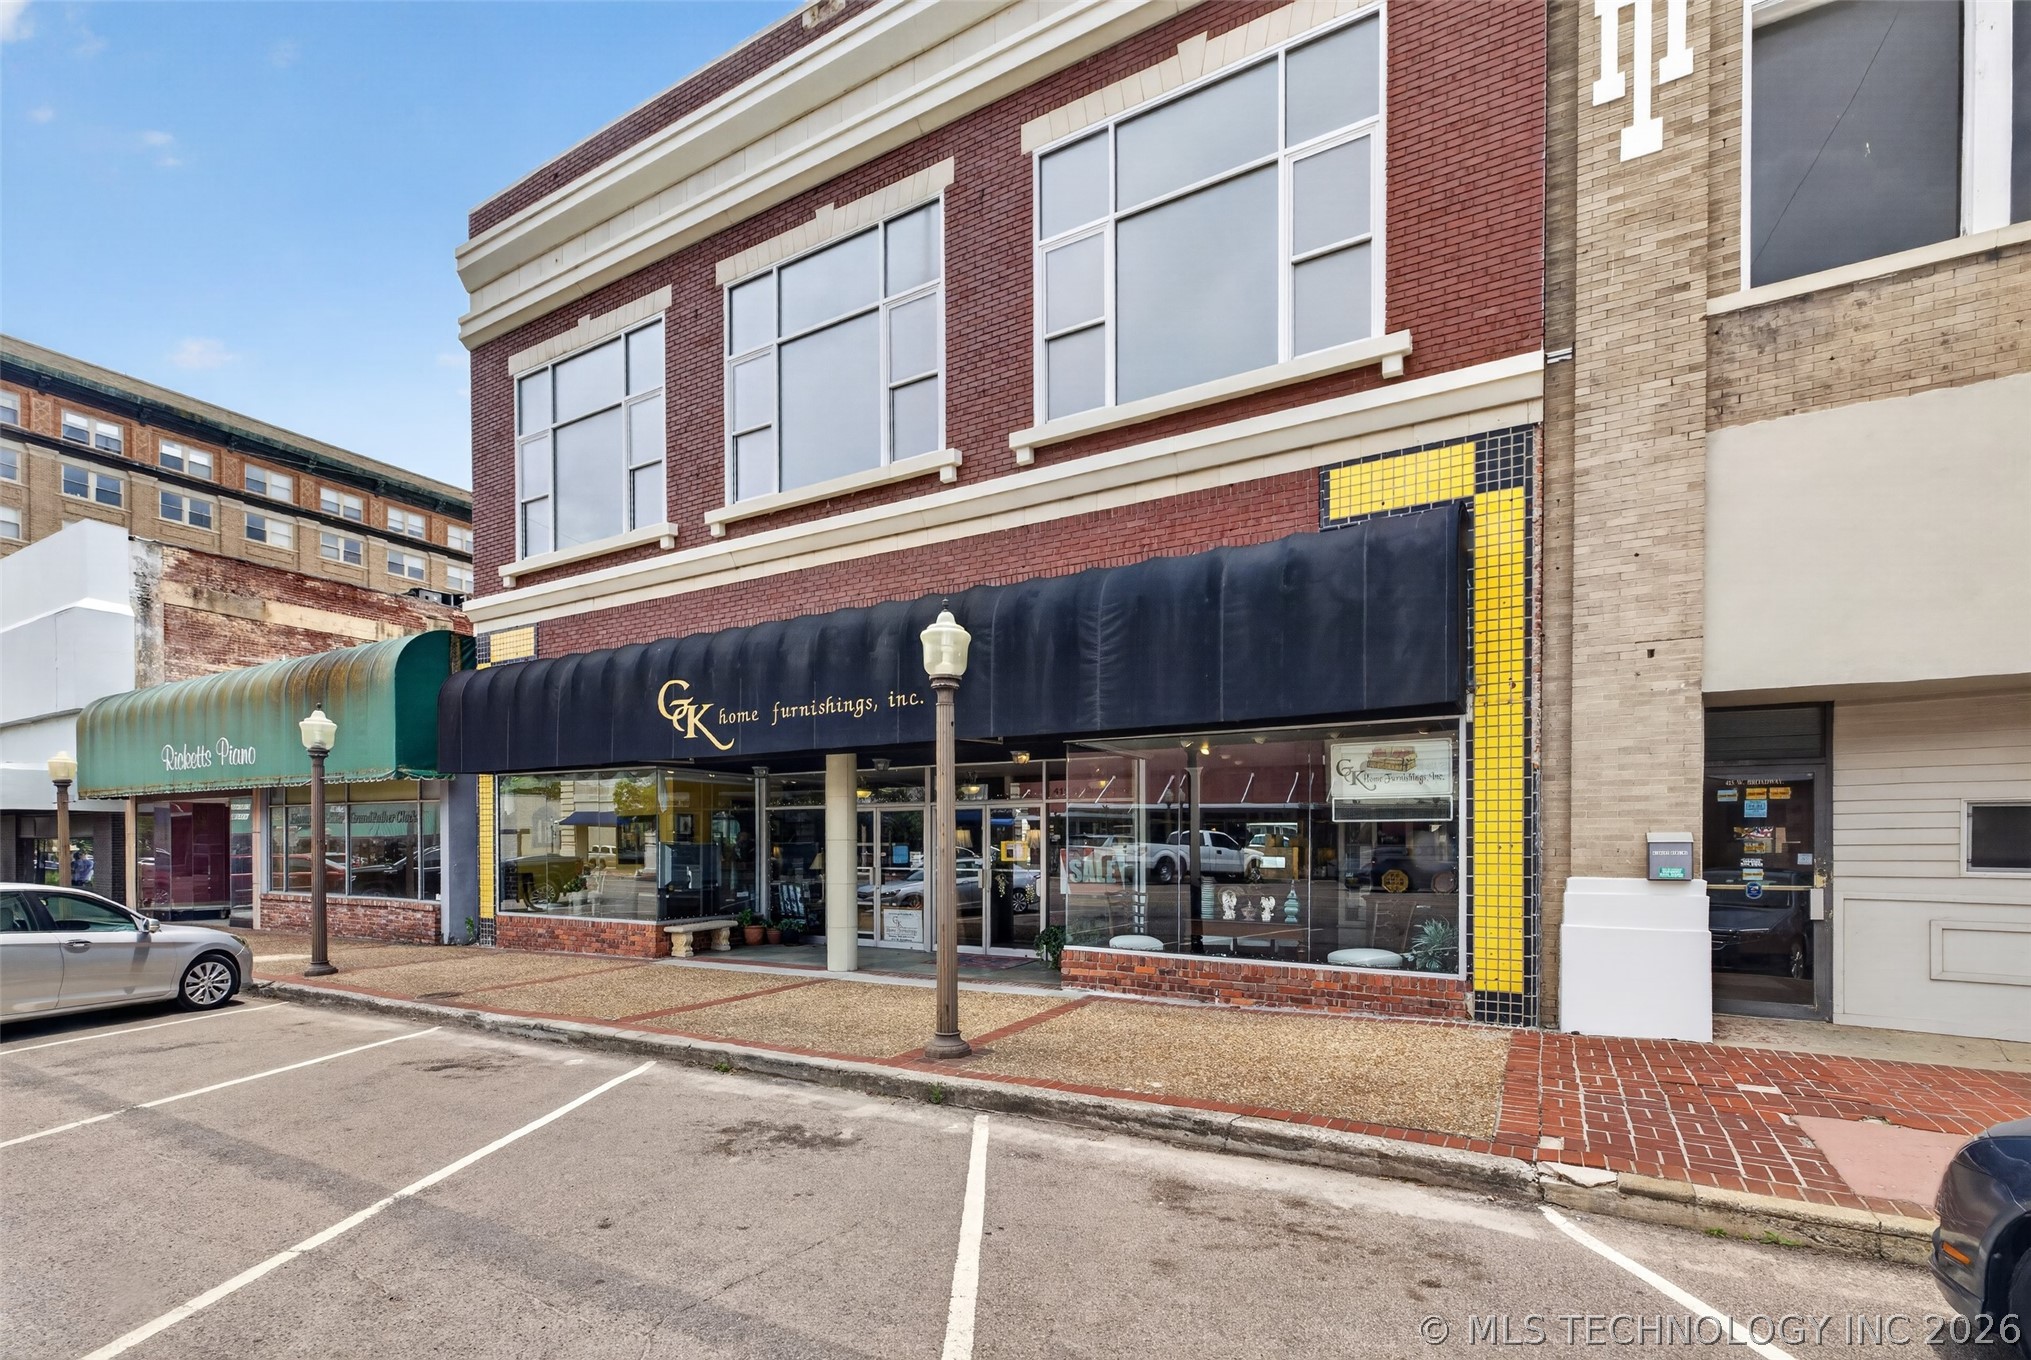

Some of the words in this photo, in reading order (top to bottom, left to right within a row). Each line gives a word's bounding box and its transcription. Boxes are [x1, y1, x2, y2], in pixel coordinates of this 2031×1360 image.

[718, 707, 760, 725] home
[771, 695, 878, 726] furnishings,
[887, 690, 924, 708] inc.
[161, 743, 212, 771] Ricketts
[215, 737, 256, 766] Piano
[1069, 854, 1117, 883] SALE
